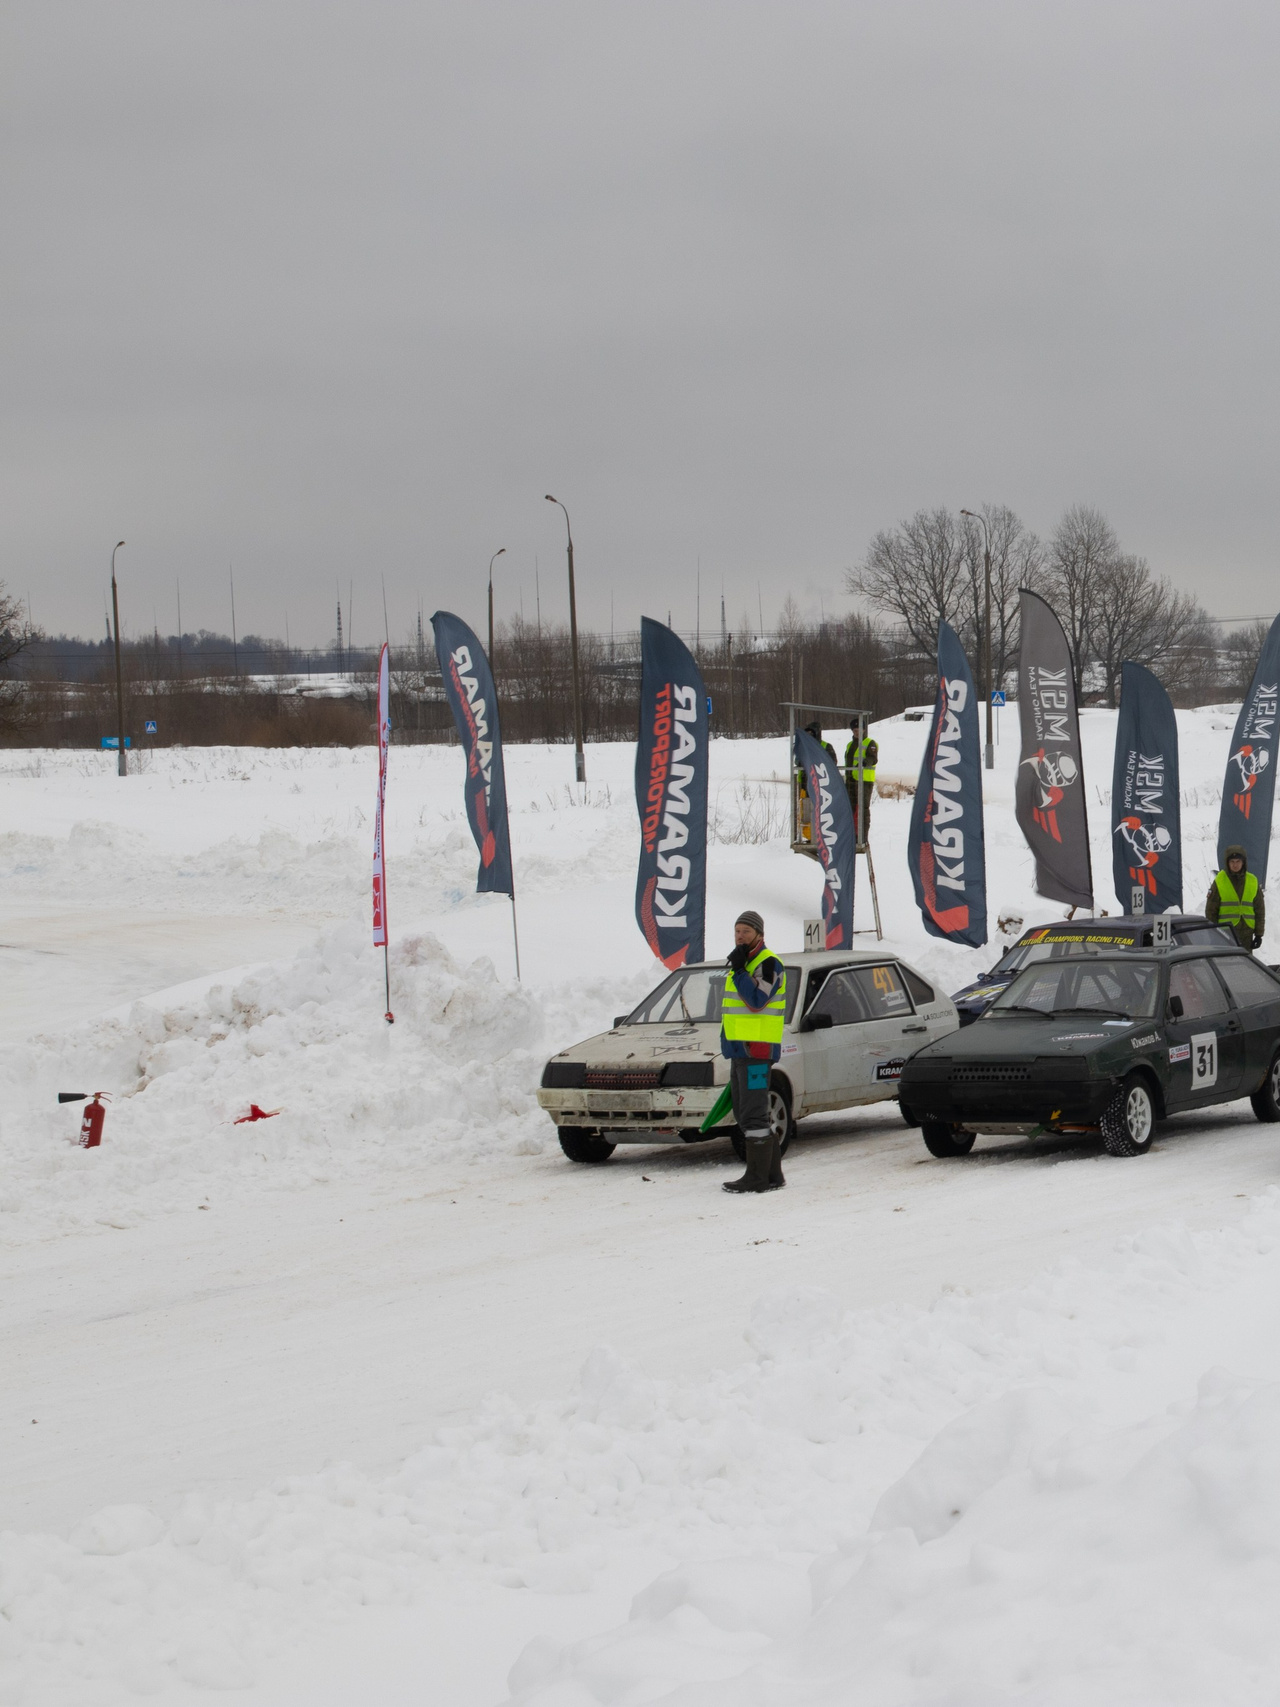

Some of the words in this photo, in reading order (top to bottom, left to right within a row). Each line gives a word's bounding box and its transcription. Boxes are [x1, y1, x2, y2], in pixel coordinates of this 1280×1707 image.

[1133, 893, 1143, 909] 13
[805, 922, 820, 945] 41
[1156, 921, 1168, 941] 31
[1018, 936, 1045, 946] FUTURE
[1044, 935, 1085, 943] CHAMPIONS
[1086, 935, 1112, 943] RACING
[1113, 937, 1135, 945] TEAM
[872, 966, 896, 996] 41
[931, 1009, 954, 1020] SOLUTIONS
[1196, 1043, 1214, 1078] 31
[879, 1066, 903, 1076] KRAM
